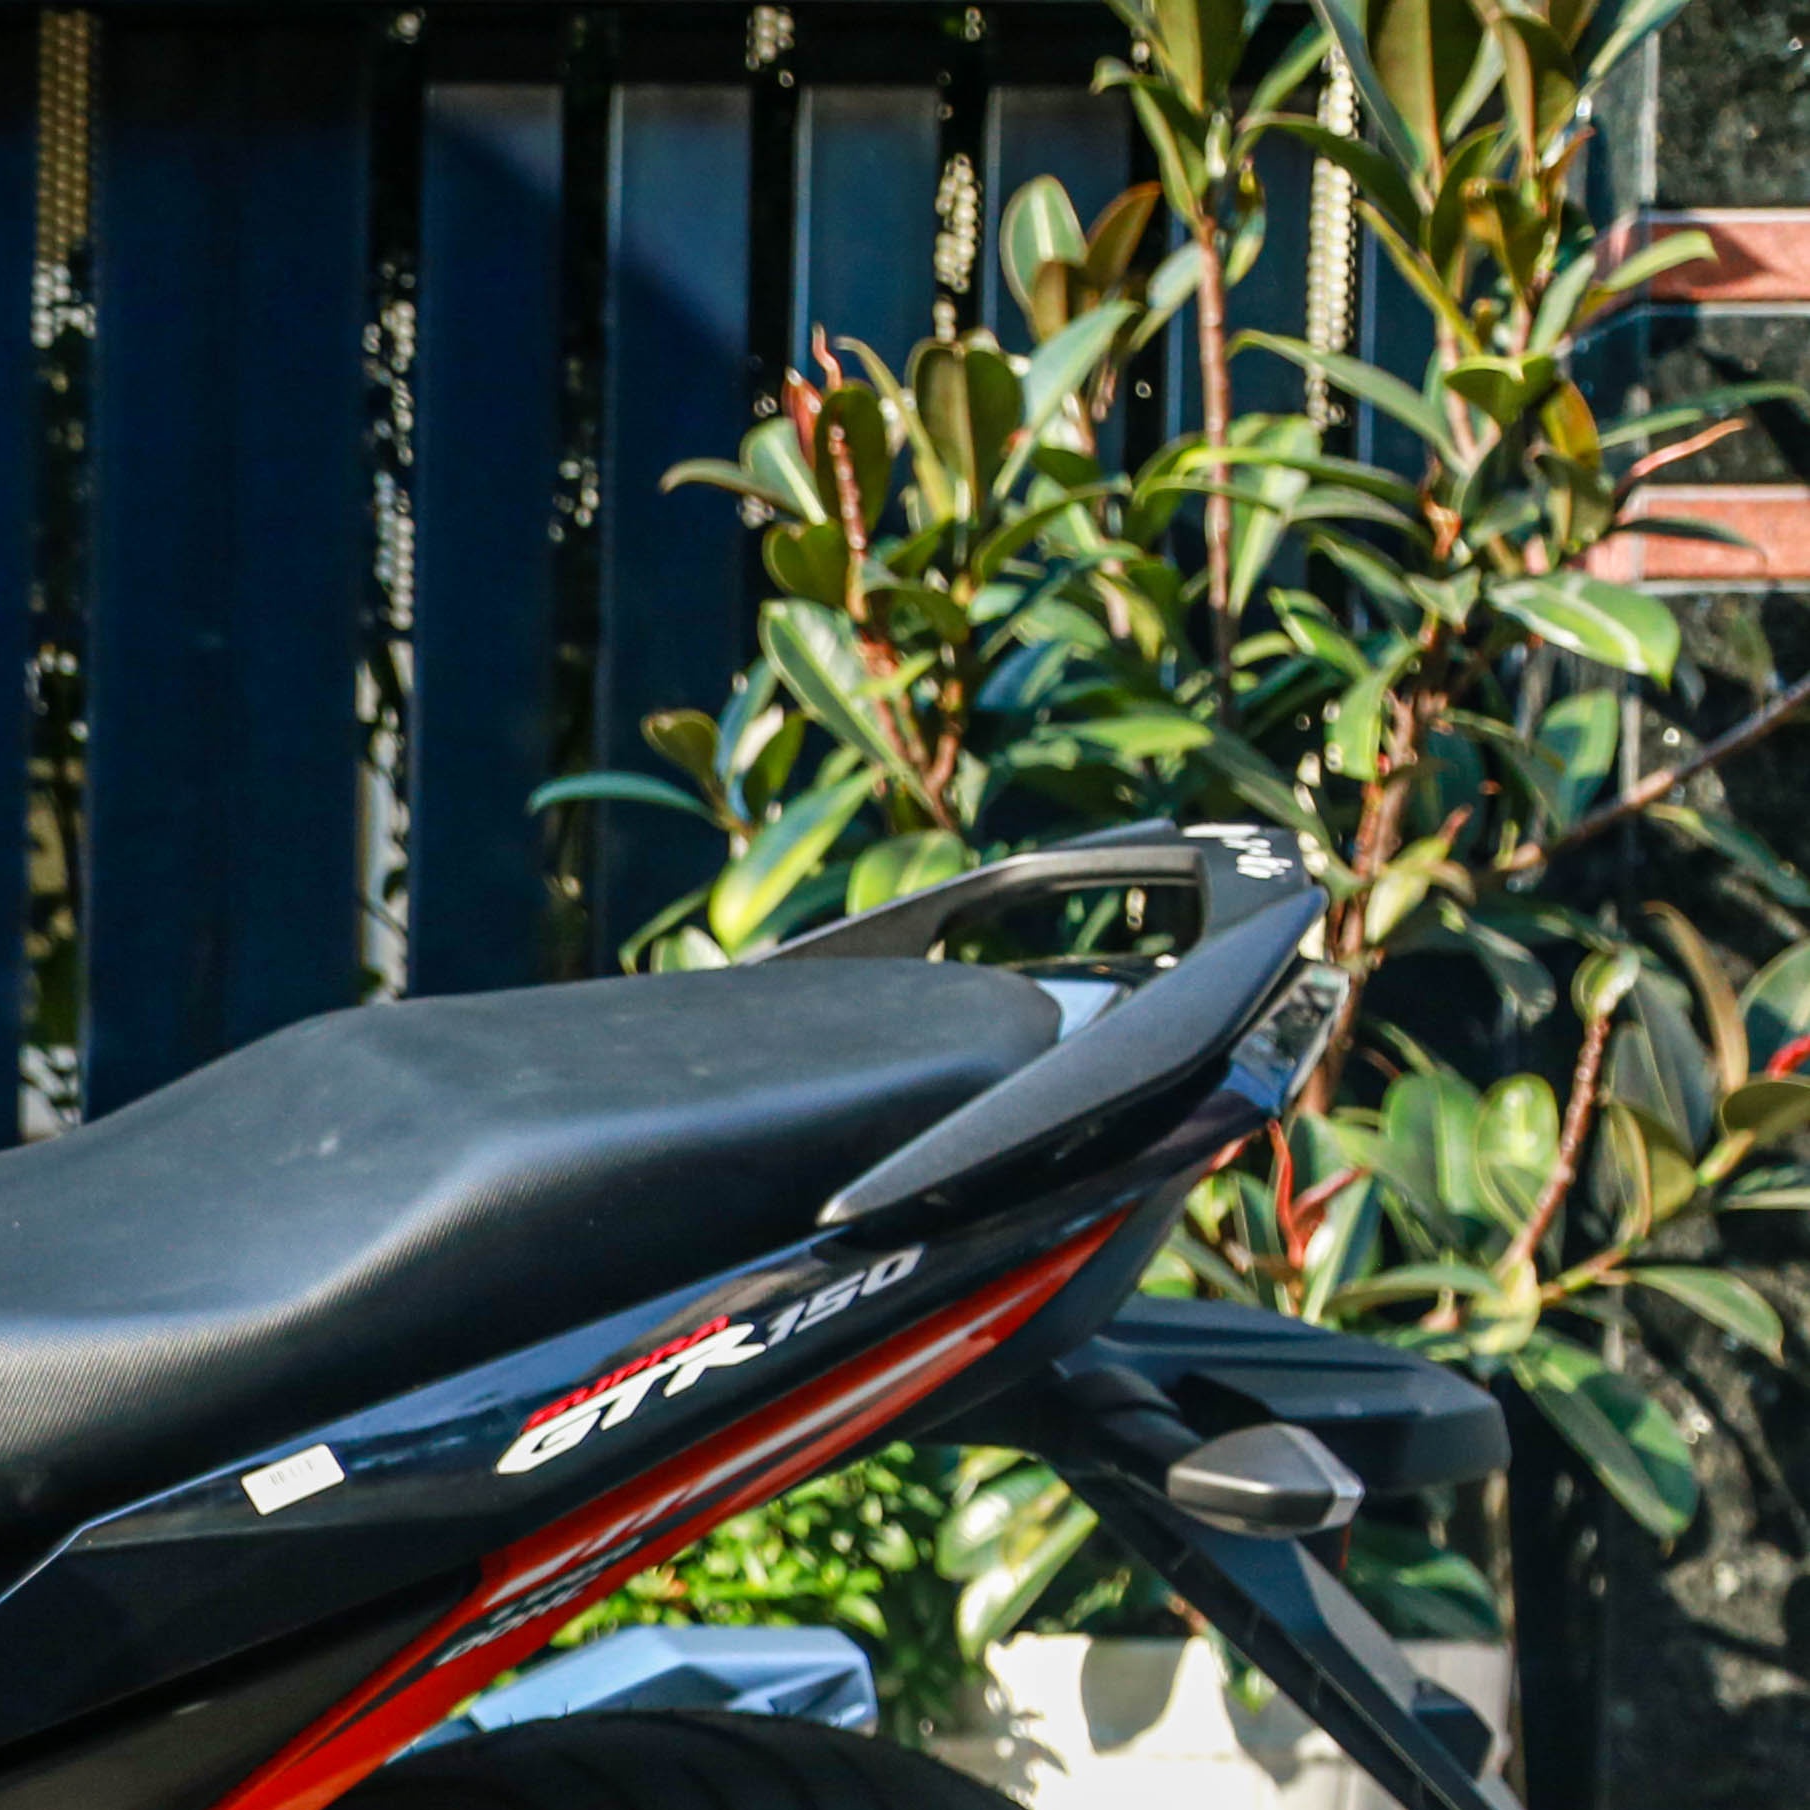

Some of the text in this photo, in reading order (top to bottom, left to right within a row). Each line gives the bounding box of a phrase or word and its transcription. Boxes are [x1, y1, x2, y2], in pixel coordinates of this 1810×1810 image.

[495, 1245, 924, 1475] GTR 150
[523, 1315, 729, 1433] SUPRA
